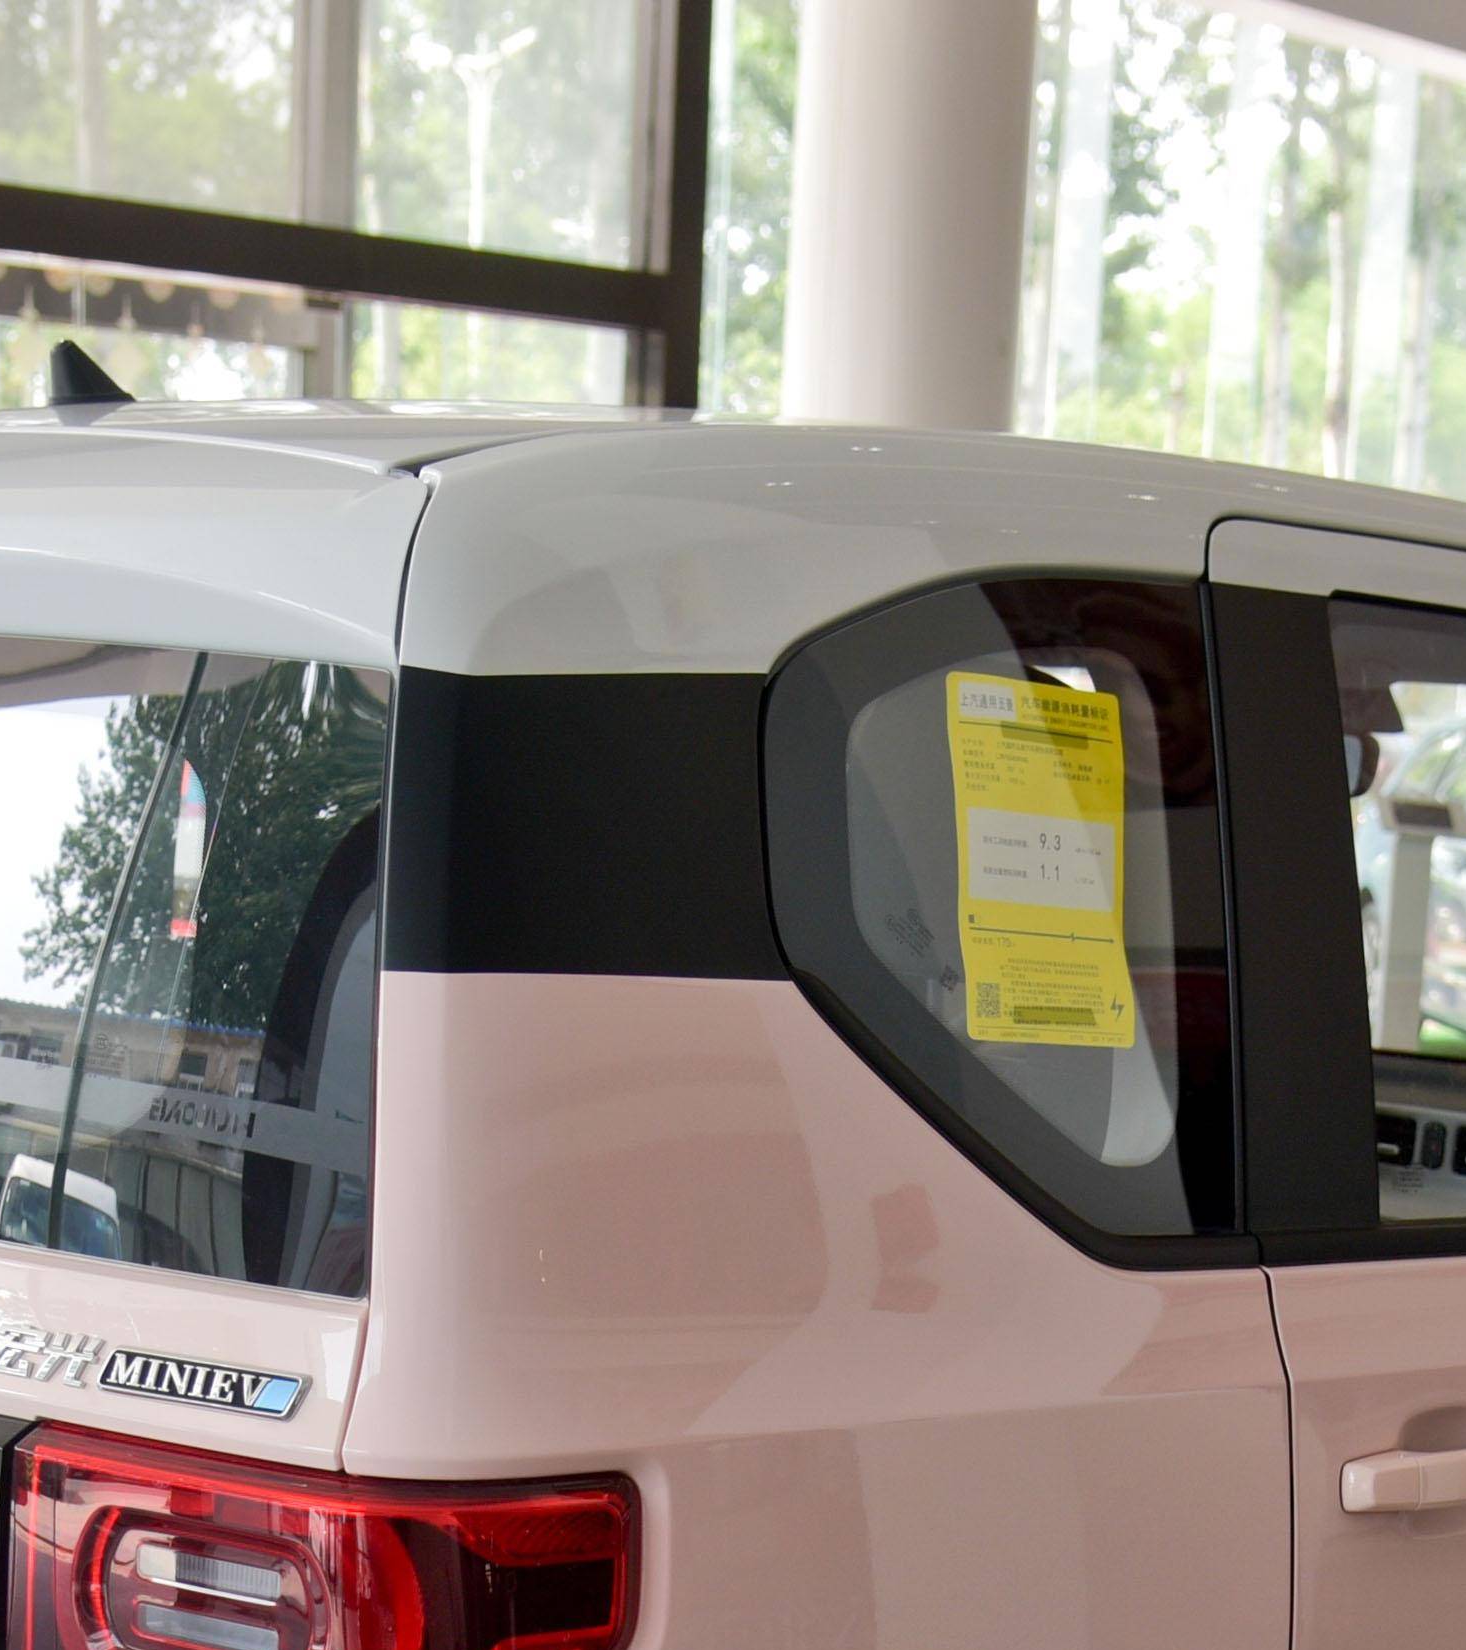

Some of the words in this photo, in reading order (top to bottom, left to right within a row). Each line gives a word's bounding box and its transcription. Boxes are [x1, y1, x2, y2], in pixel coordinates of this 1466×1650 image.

[1039, 832, 1062, 851] 9.3
[1040, 863, 1061, 882] 1.1
[105, 1351, 274, 1408] MINIEV
